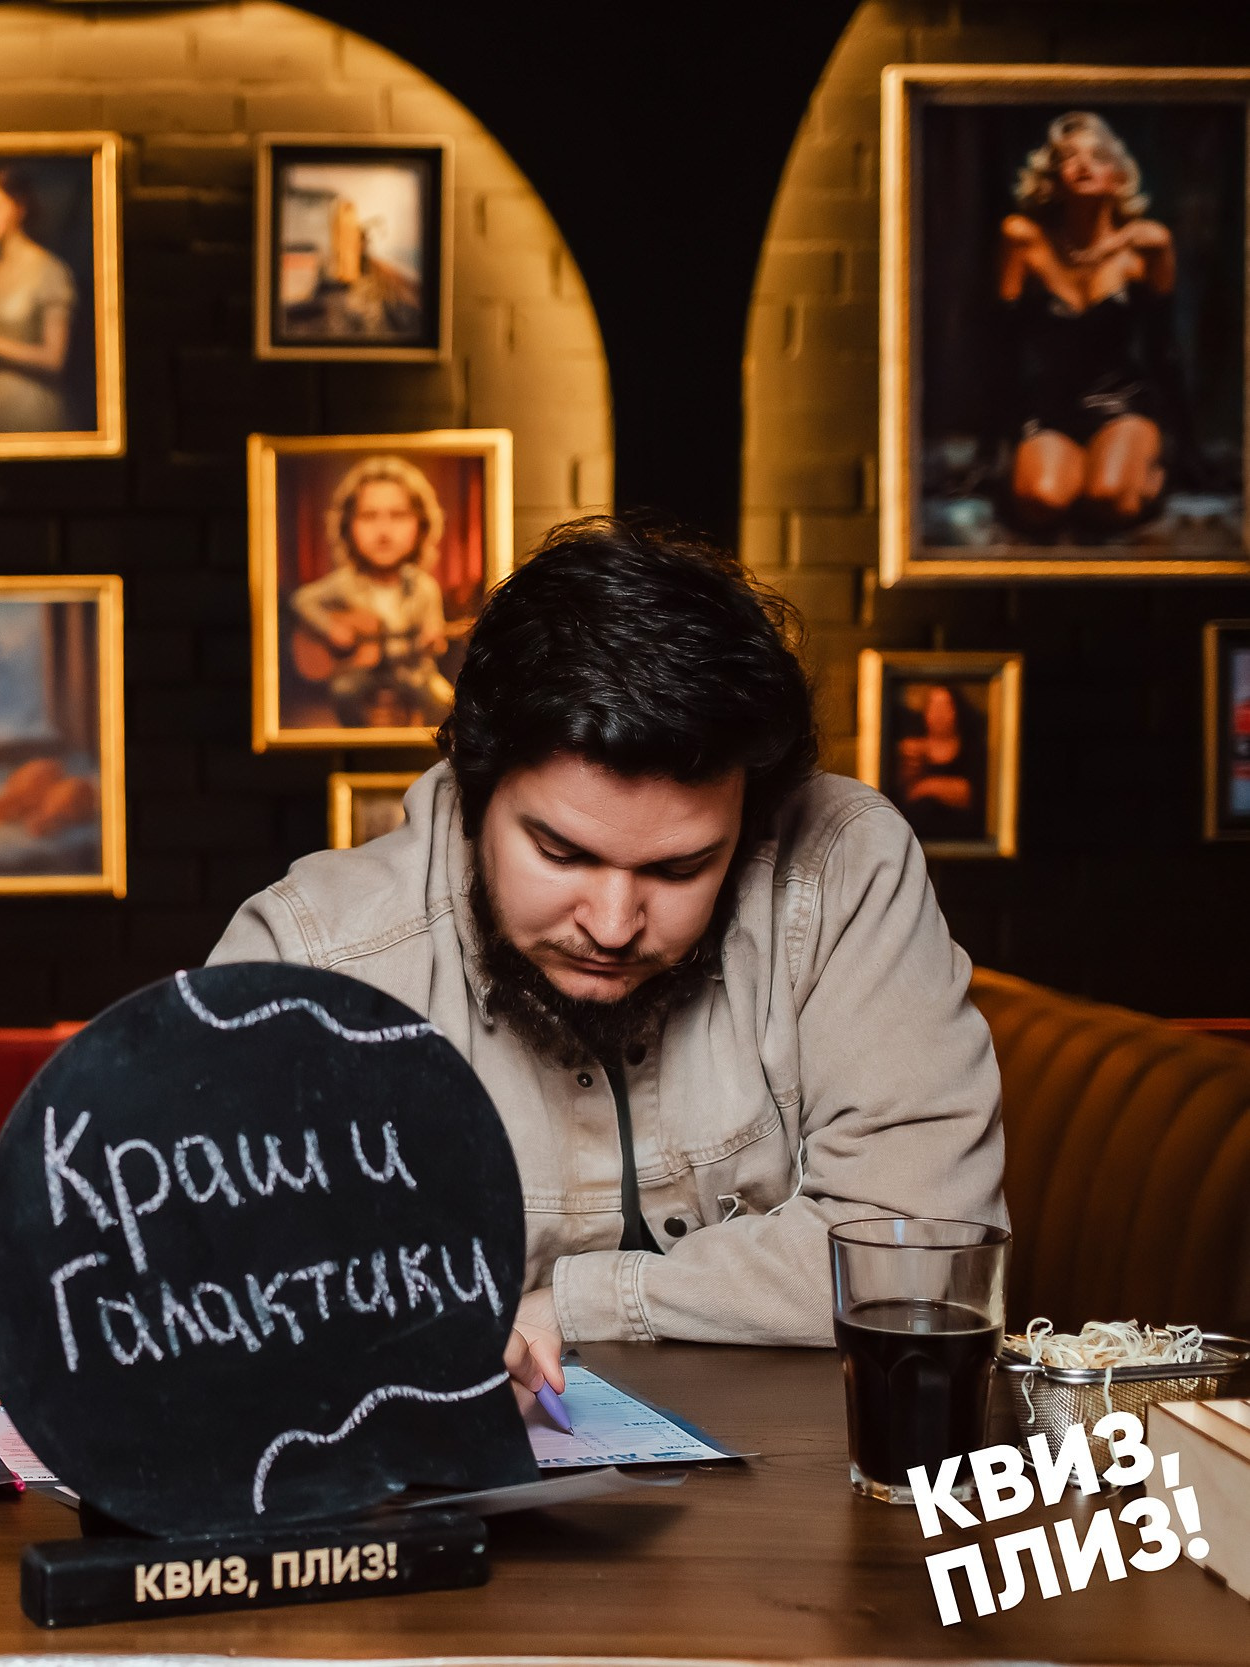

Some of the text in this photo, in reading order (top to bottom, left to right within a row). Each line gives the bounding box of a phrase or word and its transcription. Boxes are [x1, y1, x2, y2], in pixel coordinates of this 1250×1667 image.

[44, 1107, 330, 1273] Краш
[51, 1238, 503, 1372] Галактики
[135, 1542, 398, 1603] КВИЗ, ПЛИЗ!
